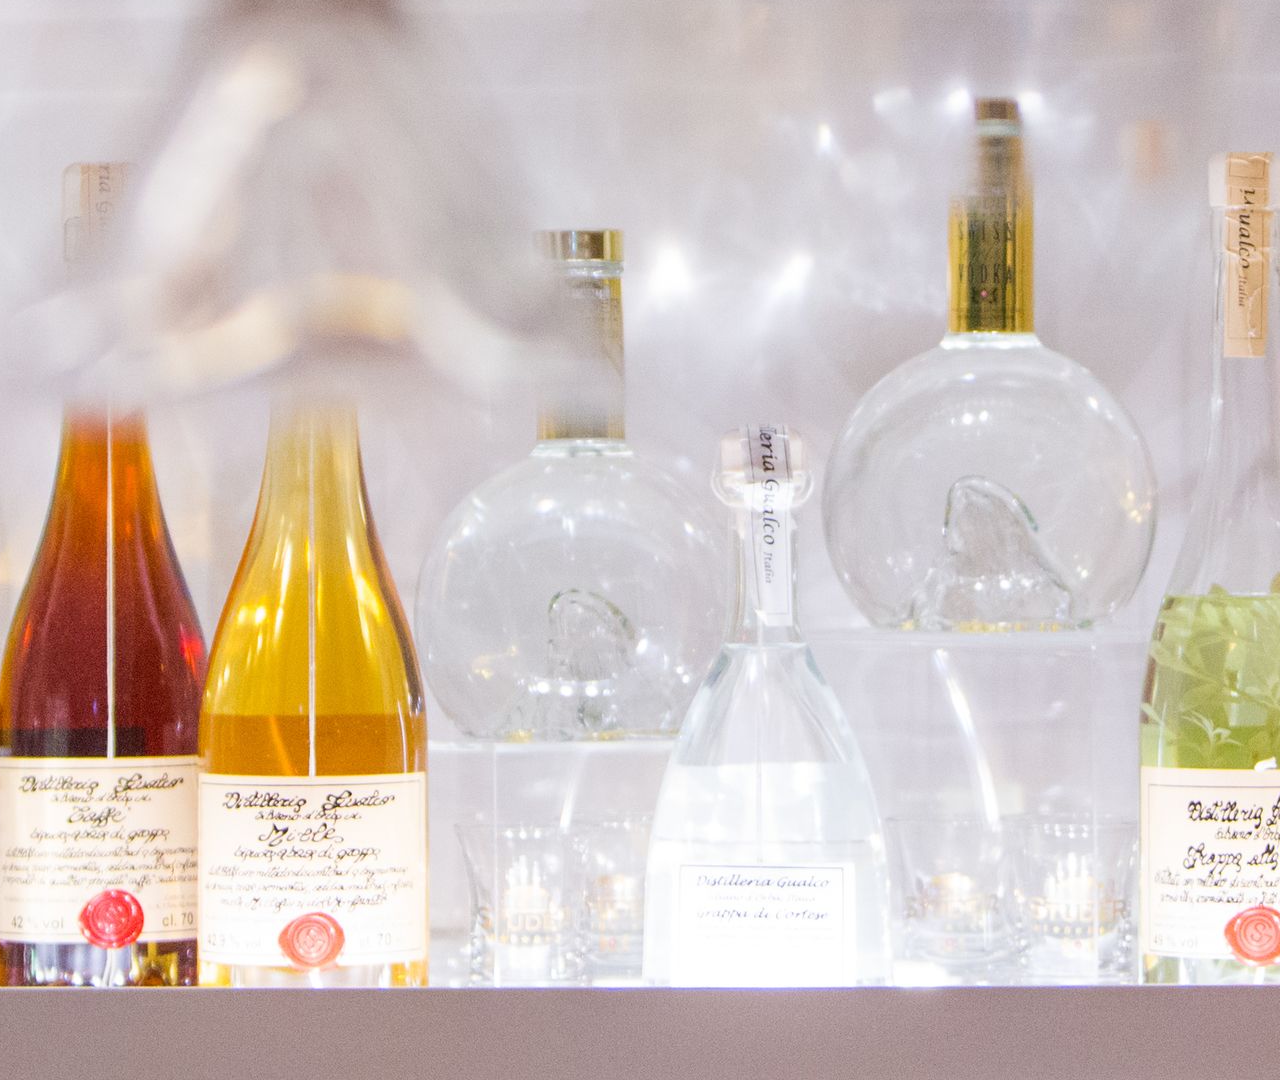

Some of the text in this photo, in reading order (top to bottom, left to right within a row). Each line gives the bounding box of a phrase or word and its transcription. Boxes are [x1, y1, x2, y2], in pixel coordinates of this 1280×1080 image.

[762, 479, 780, 546] Gualco
[696, 874, 830, 888] Distilleria Gualco
[181, 912, 194, 925] 70
